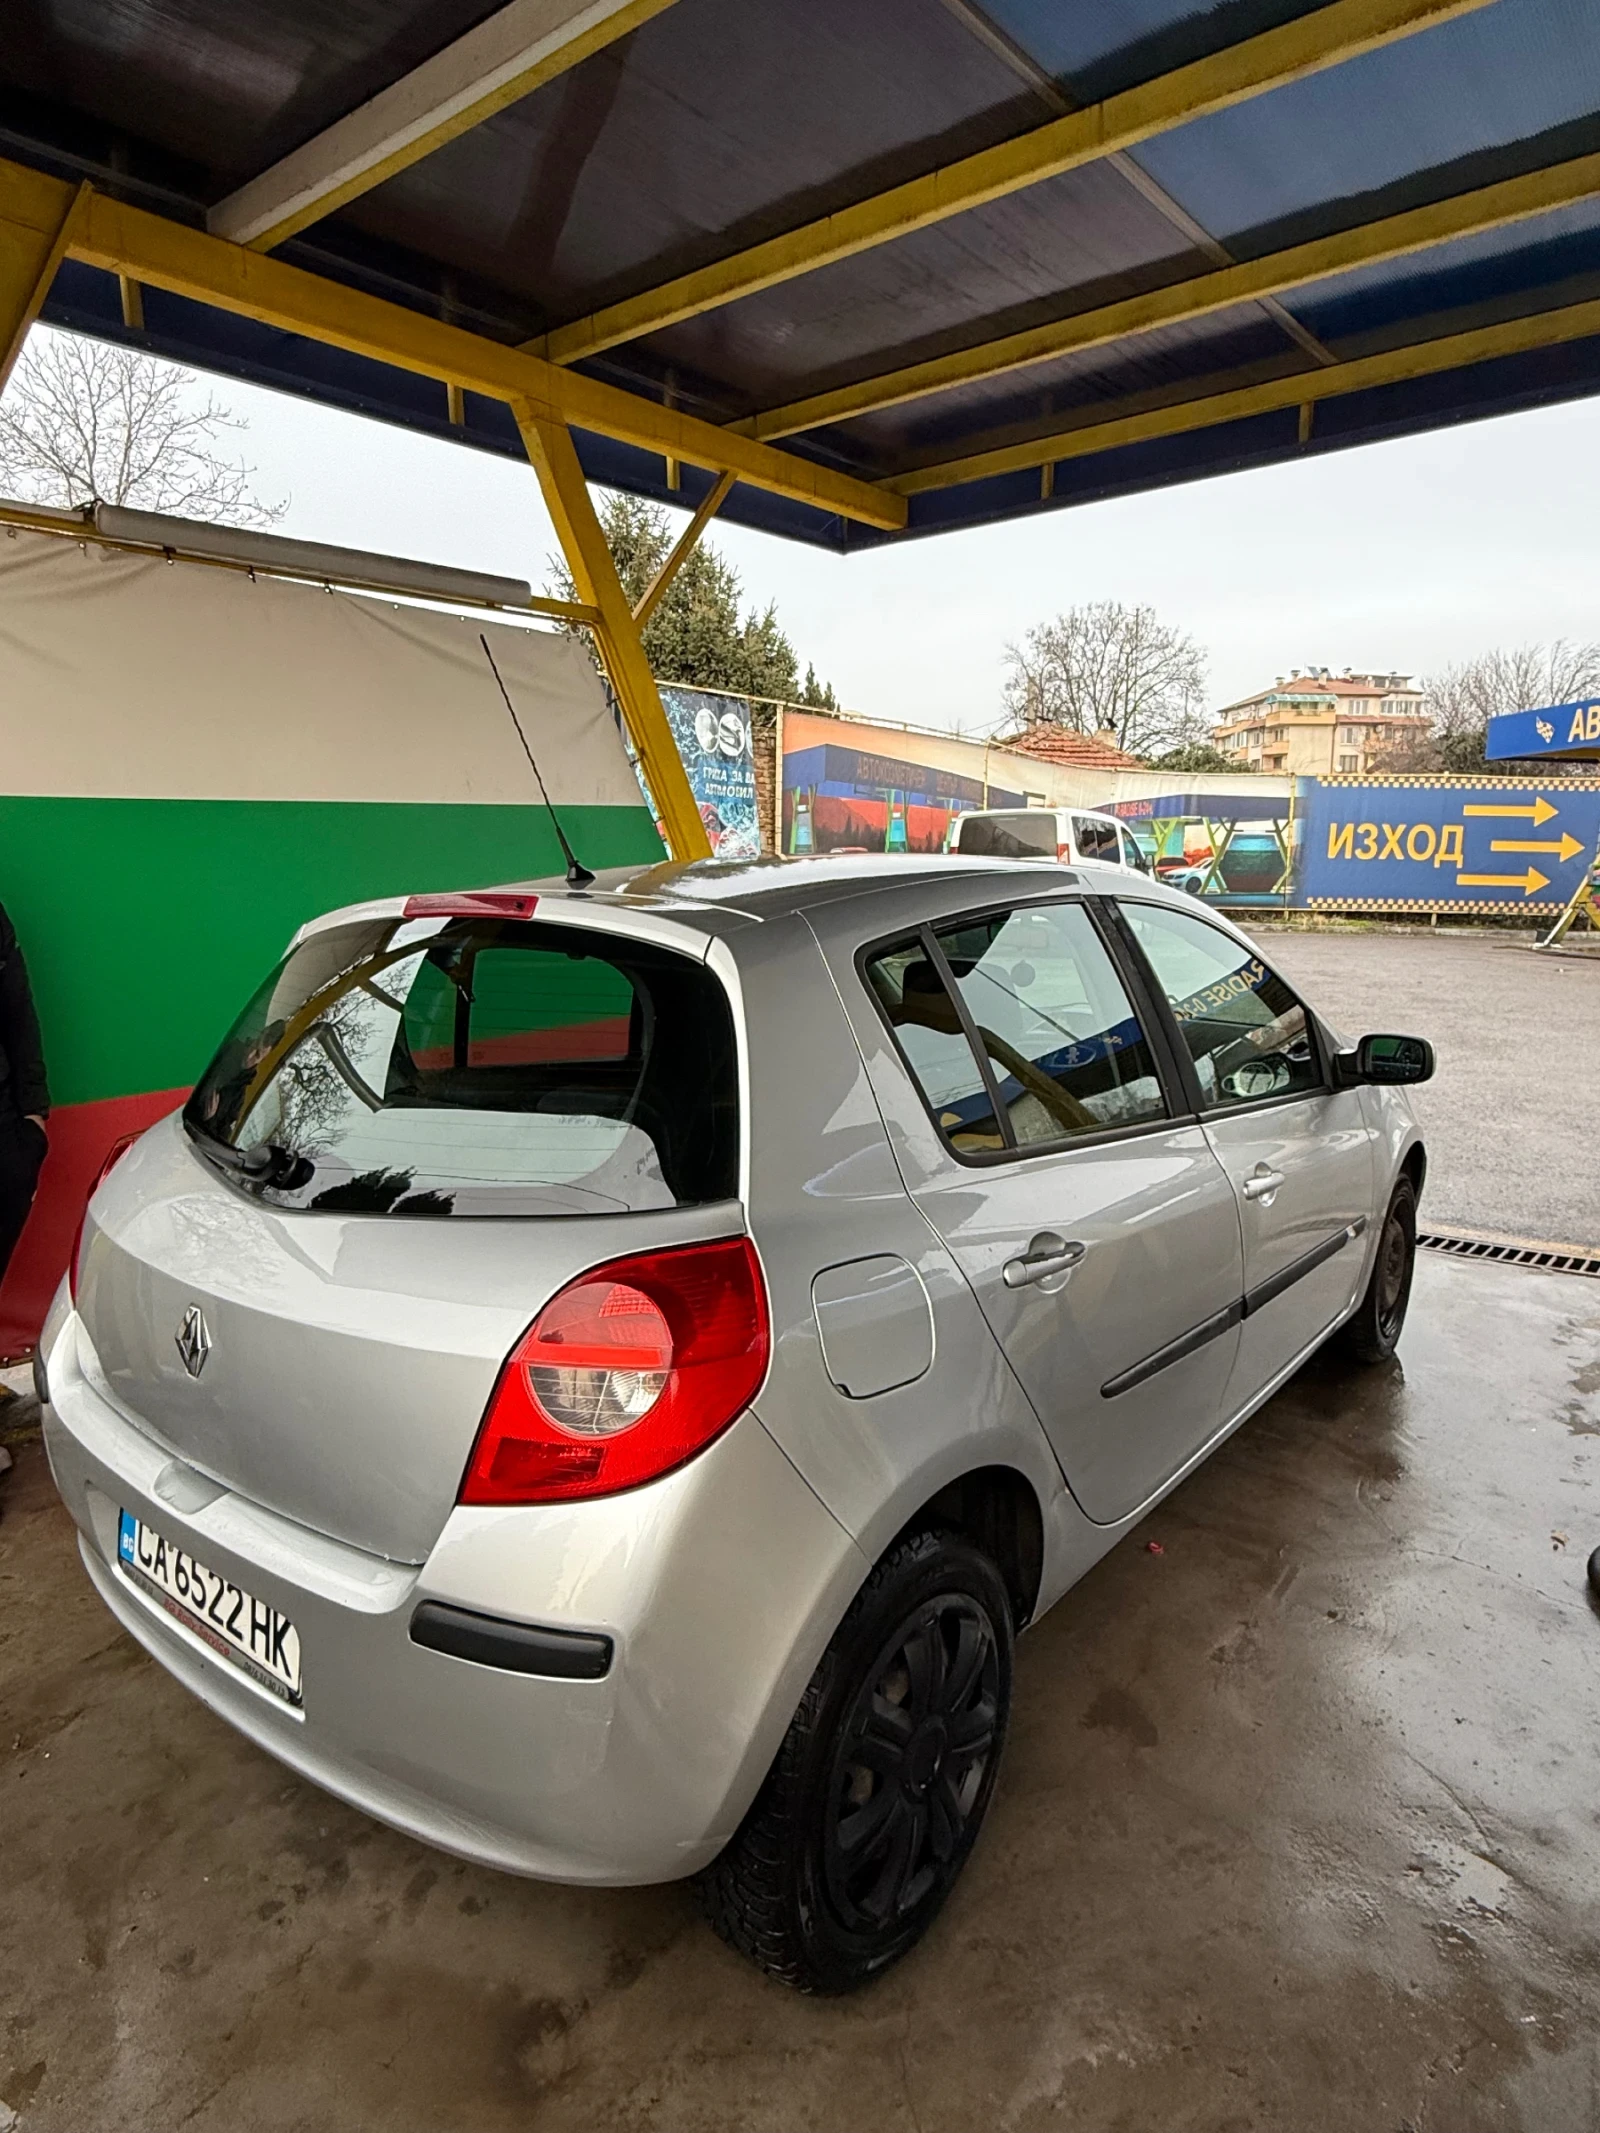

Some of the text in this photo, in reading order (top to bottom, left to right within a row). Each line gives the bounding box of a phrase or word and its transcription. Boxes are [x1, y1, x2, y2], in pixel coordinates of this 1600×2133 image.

[731, 770, 743, 784] ЗА
[1327, 822, 1465, 869] ИЗХОД
[123, 1532, 134, 1554] BG
